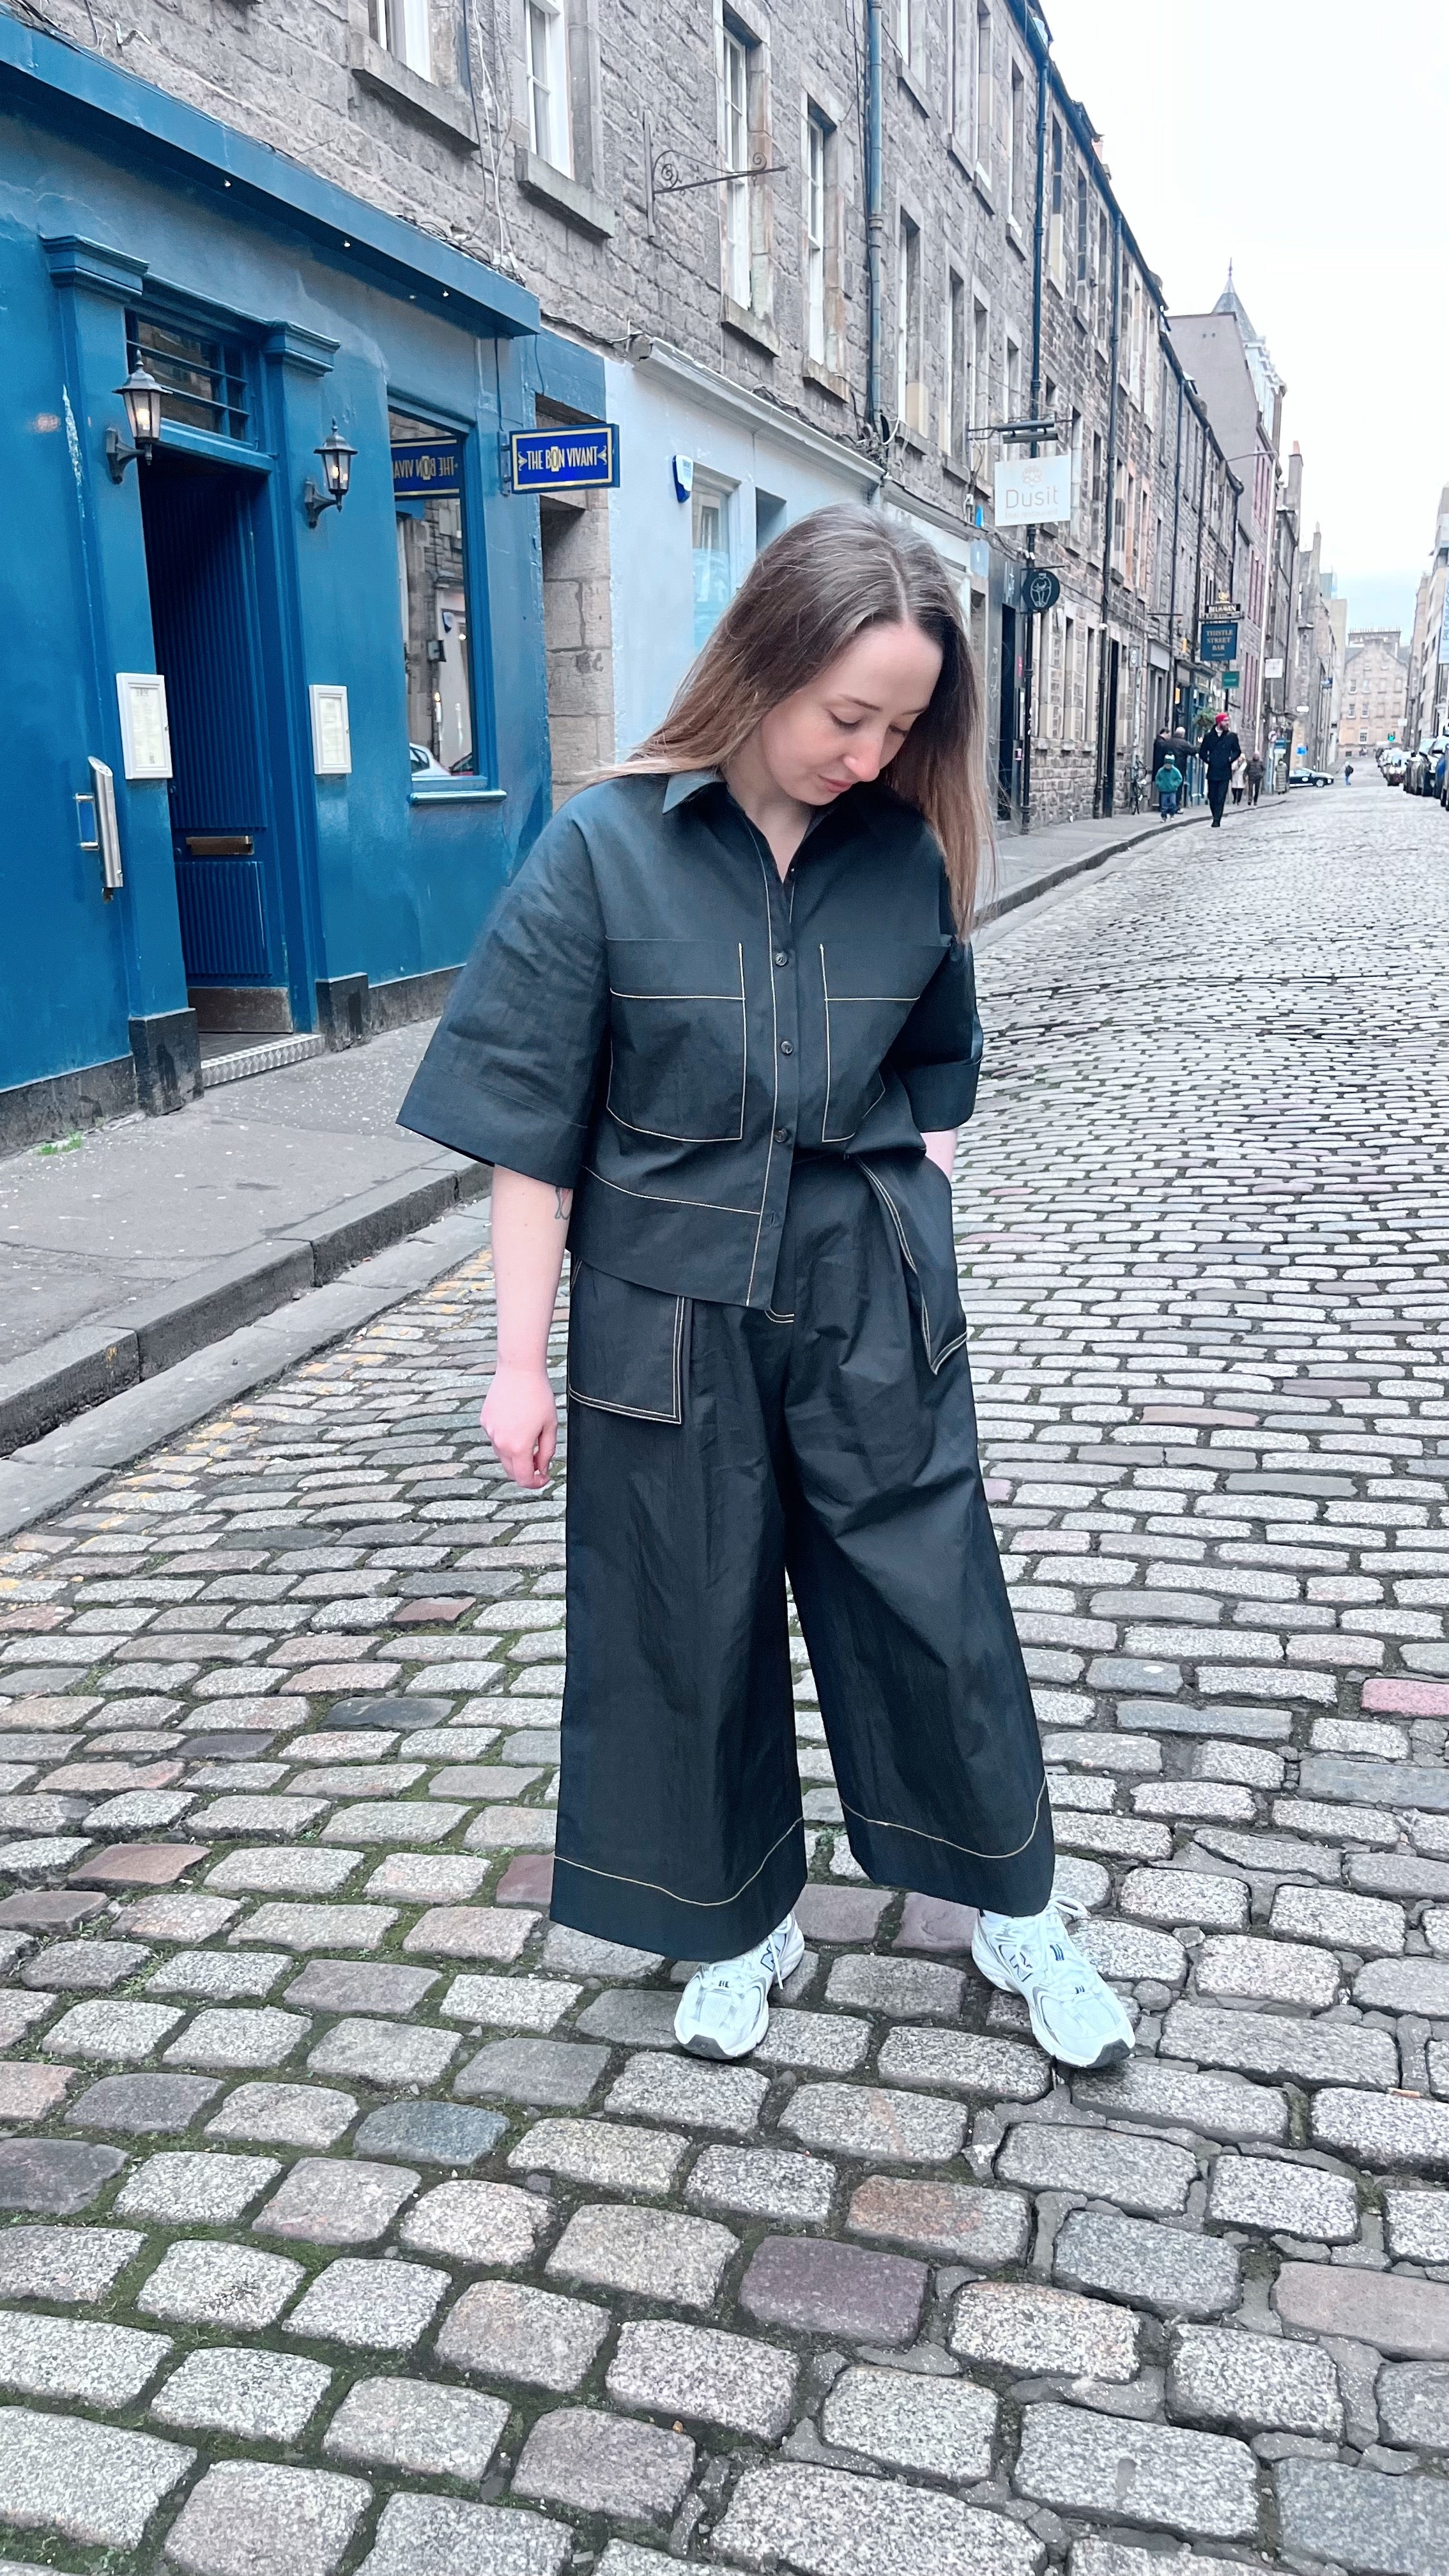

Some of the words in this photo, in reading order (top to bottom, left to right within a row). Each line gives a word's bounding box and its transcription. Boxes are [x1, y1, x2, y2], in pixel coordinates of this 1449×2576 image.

[526, 450, 544, 470] THE
[546, 446, 565, 471] BON
[567, 446, 598, 467] VIVANT
[1006, 486, 1059, 508] Dusit
